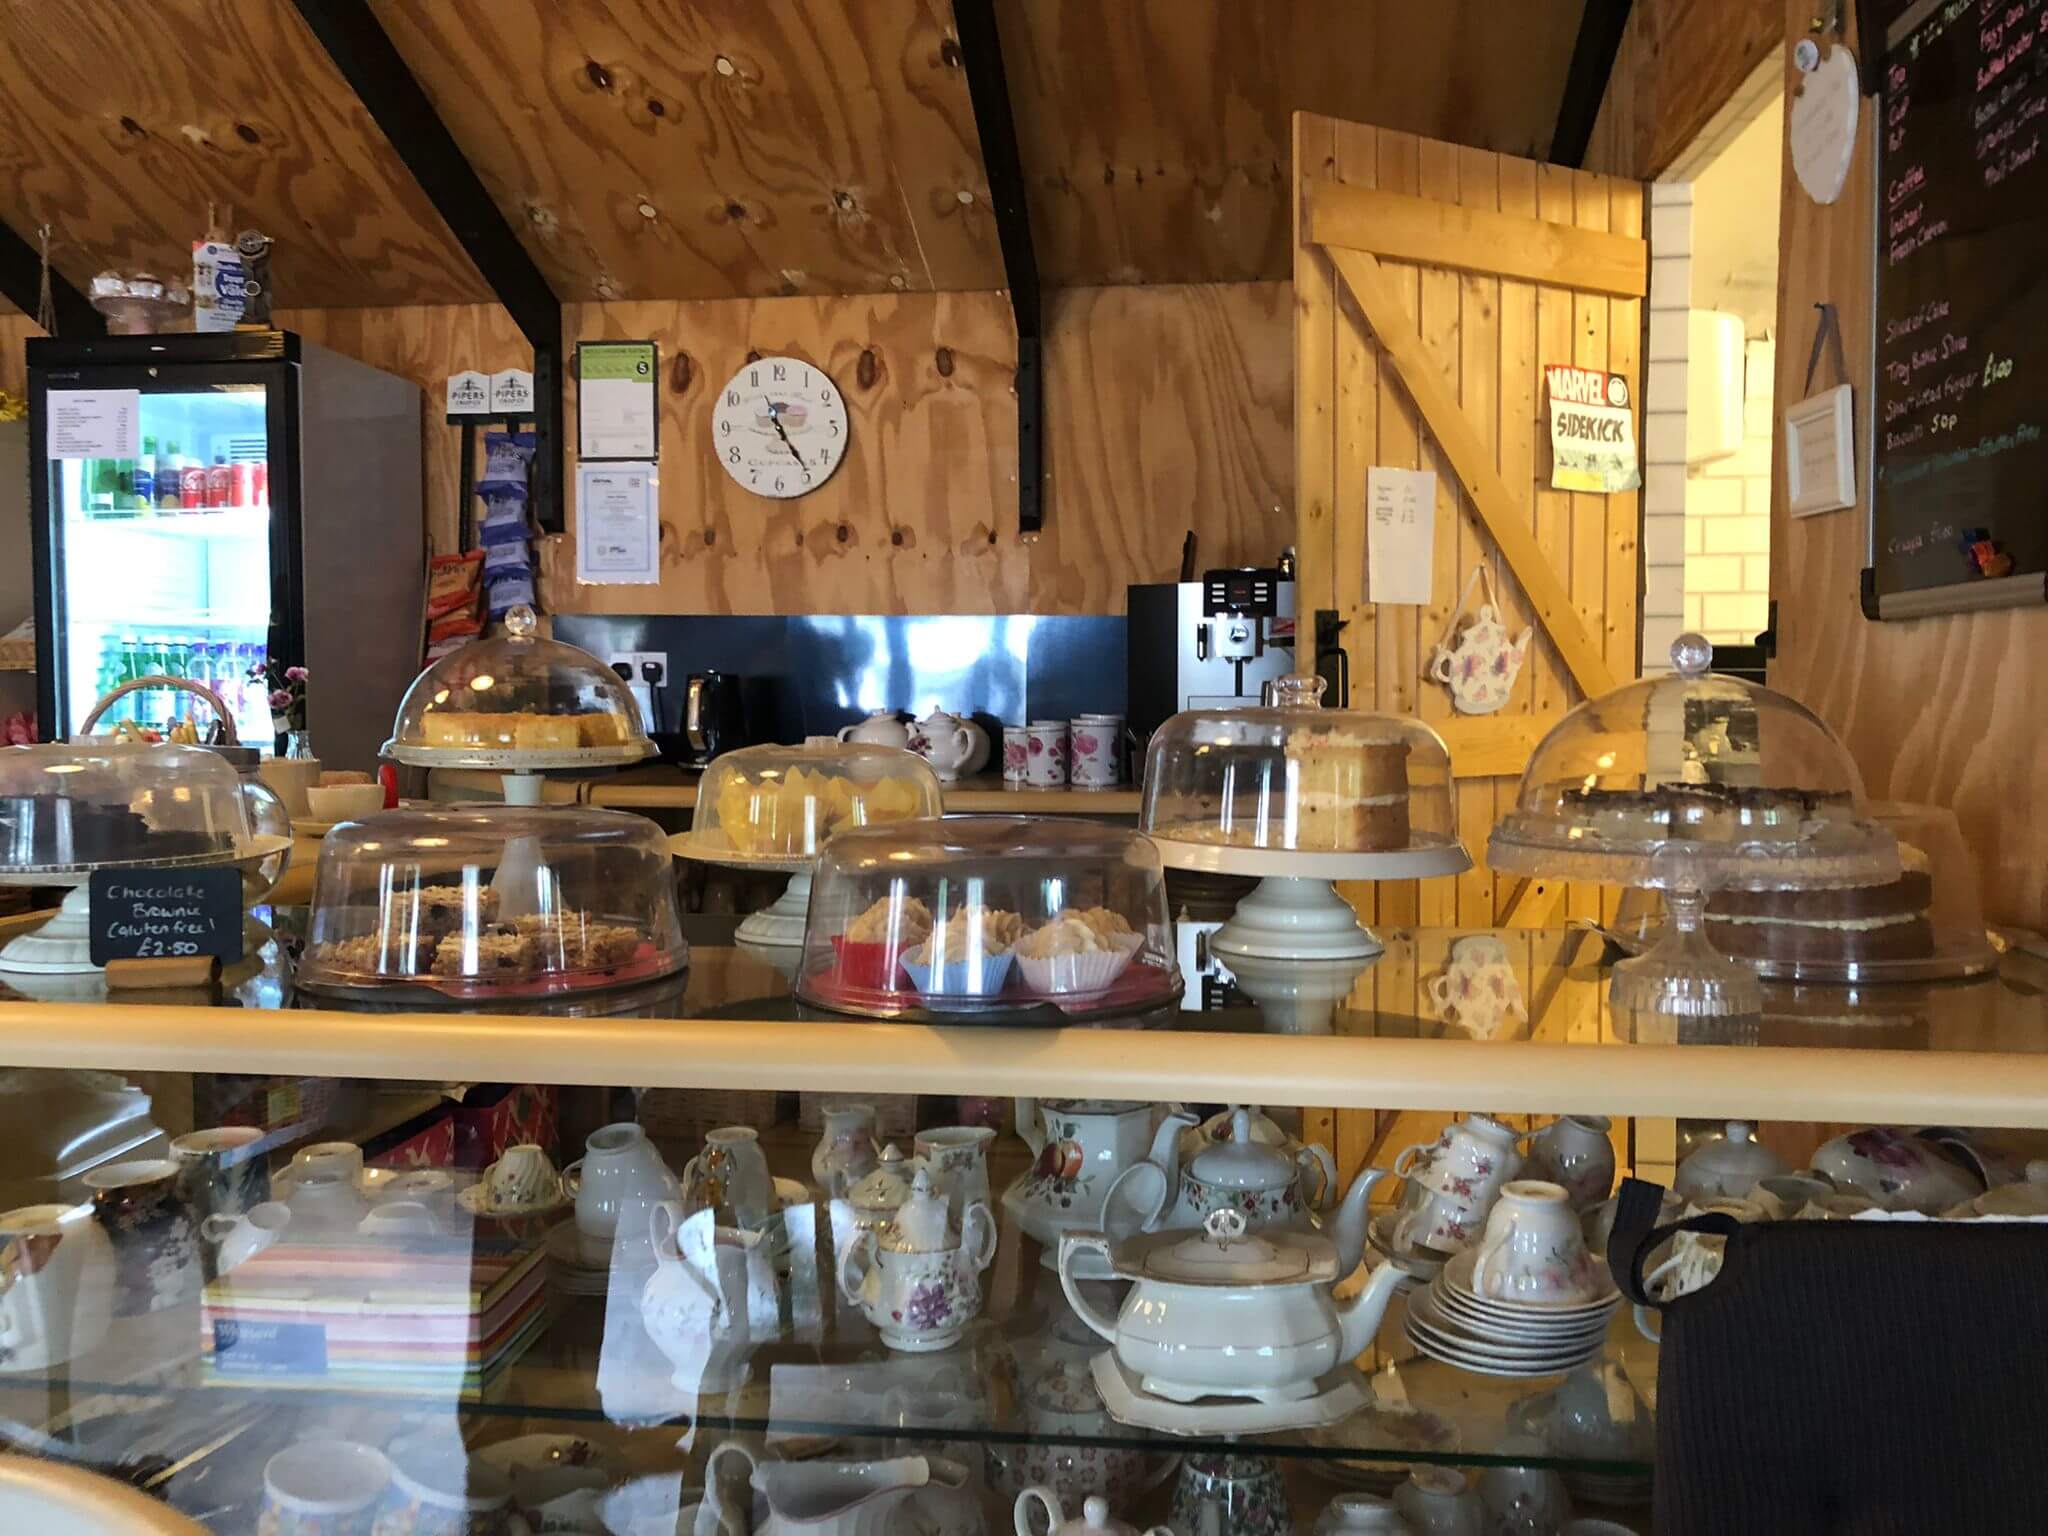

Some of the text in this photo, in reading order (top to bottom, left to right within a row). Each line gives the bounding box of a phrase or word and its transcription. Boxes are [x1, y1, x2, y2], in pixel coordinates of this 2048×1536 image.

[638, 363, 647, 373] 5
[773, 364, 786, 381] 12
[1885, 361, 1910, 386] Tray
[751, 370, 759, 387] 11
[1547, 368, 1606, 405] MARVEL
[452, 391, 485, 400] PIPERS
[495, 390, 529, 398] PIPERS
[727, 390, 740, 407] 10
[821, 389, 831, 408] 2
[721, 420, 731, 438] 9
[1556, 411, 1625, 443] SIDEKICK
[729, 446, 741, 464] 8
[821, 448, 831, 465] 4
[750, 468, 762, 485] 7
[775, 473, 785, 492] 6
[801, 468, 811, 484] 5
[107, 885, 204, 899] Chocolate
[132, 903, 201, 919] Brownie
[136, 937, 199, 956] £2.50
